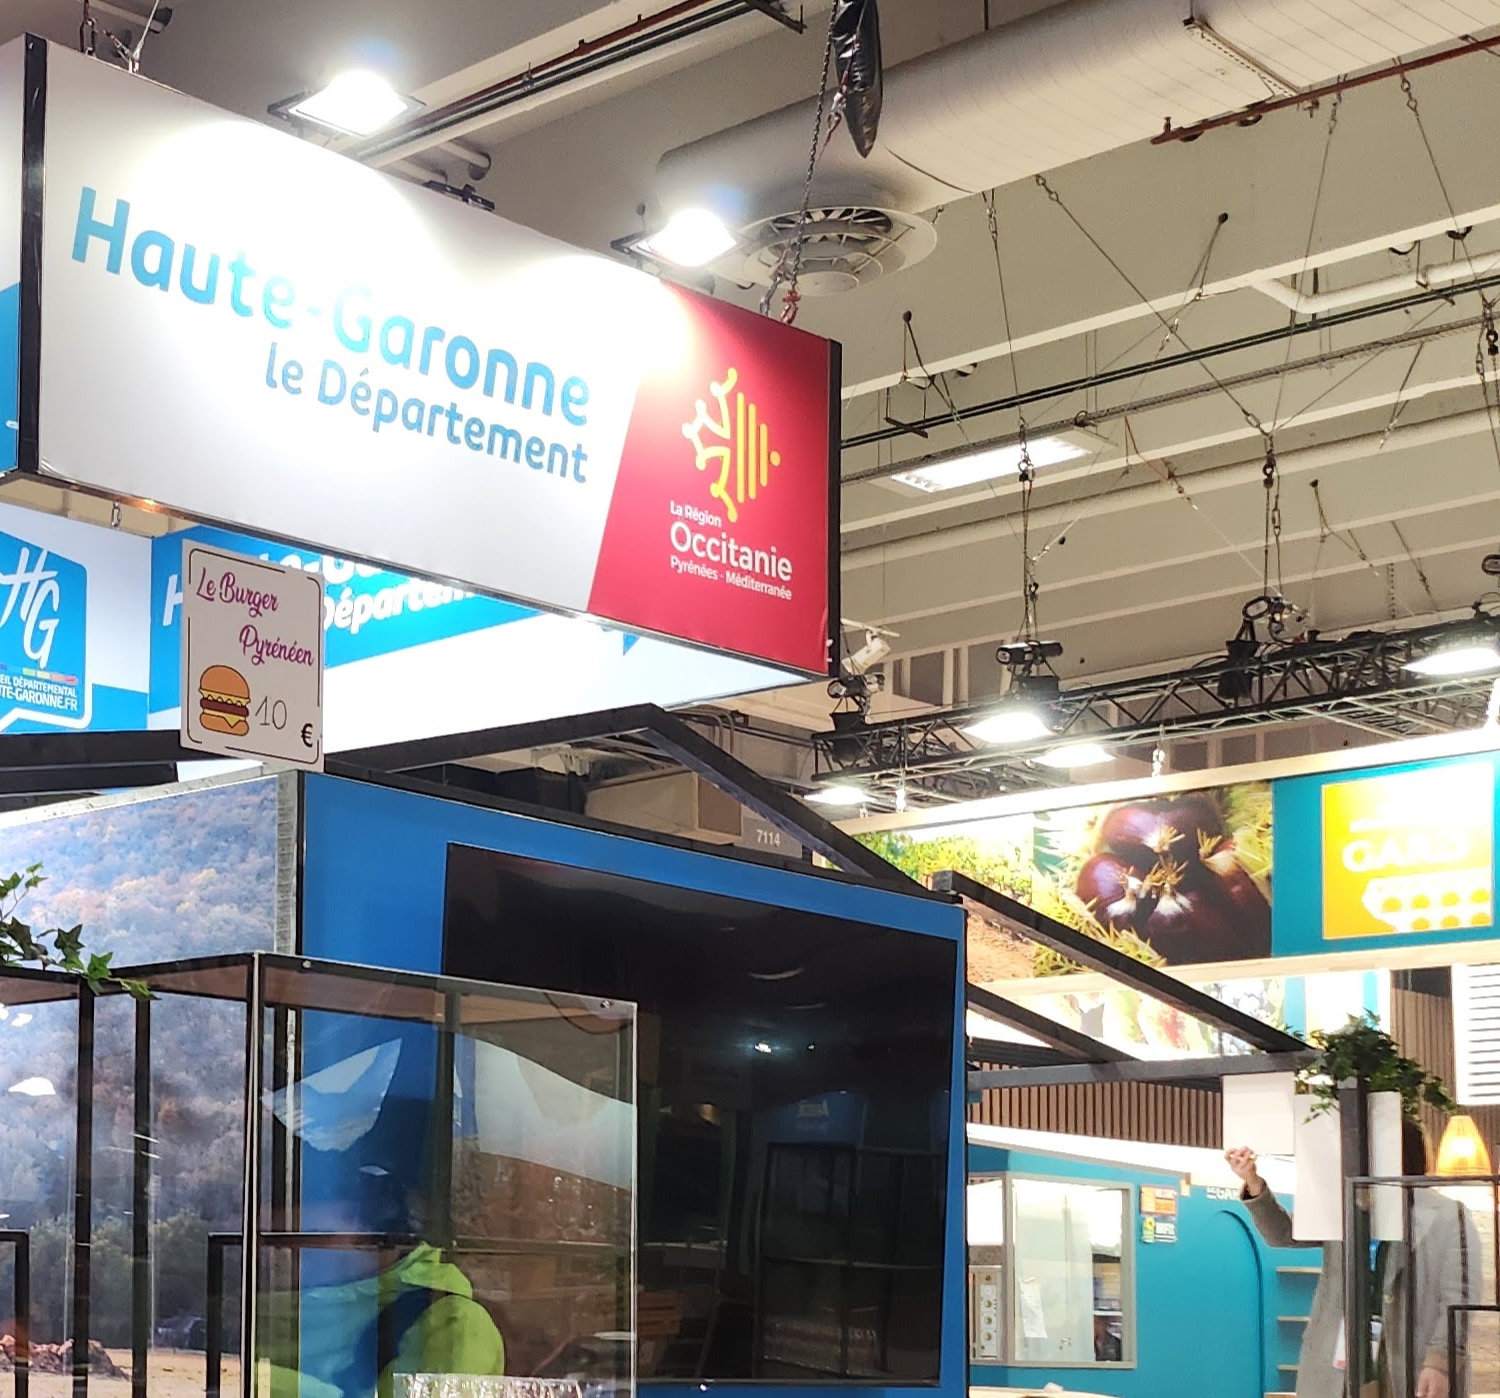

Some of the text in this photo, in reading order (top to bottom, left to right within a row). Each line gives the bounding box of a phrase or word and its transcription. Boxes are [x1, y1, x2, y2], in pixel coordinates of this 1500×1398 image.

[72, 185, 590, 427] Haute-Garonne
[265, 341, 588, 484] le Département
[670, 500, 722, 528] La Région
[670, 521, 792, 582] Occitanie
[195, 567, 217, 601] Le
[219, 571, 279, 617] Burger
[670, 555, 718, 581] Pyrénées
[725, 570, 792, 600] Méditerranée
[238, 624, 315, 667] Pyrénéen
[12, 673, 78, 699] DÉPARTEMENTAL
[255, 694, 314, 748] 10 €
[756, 829, 781, 847] 7114
